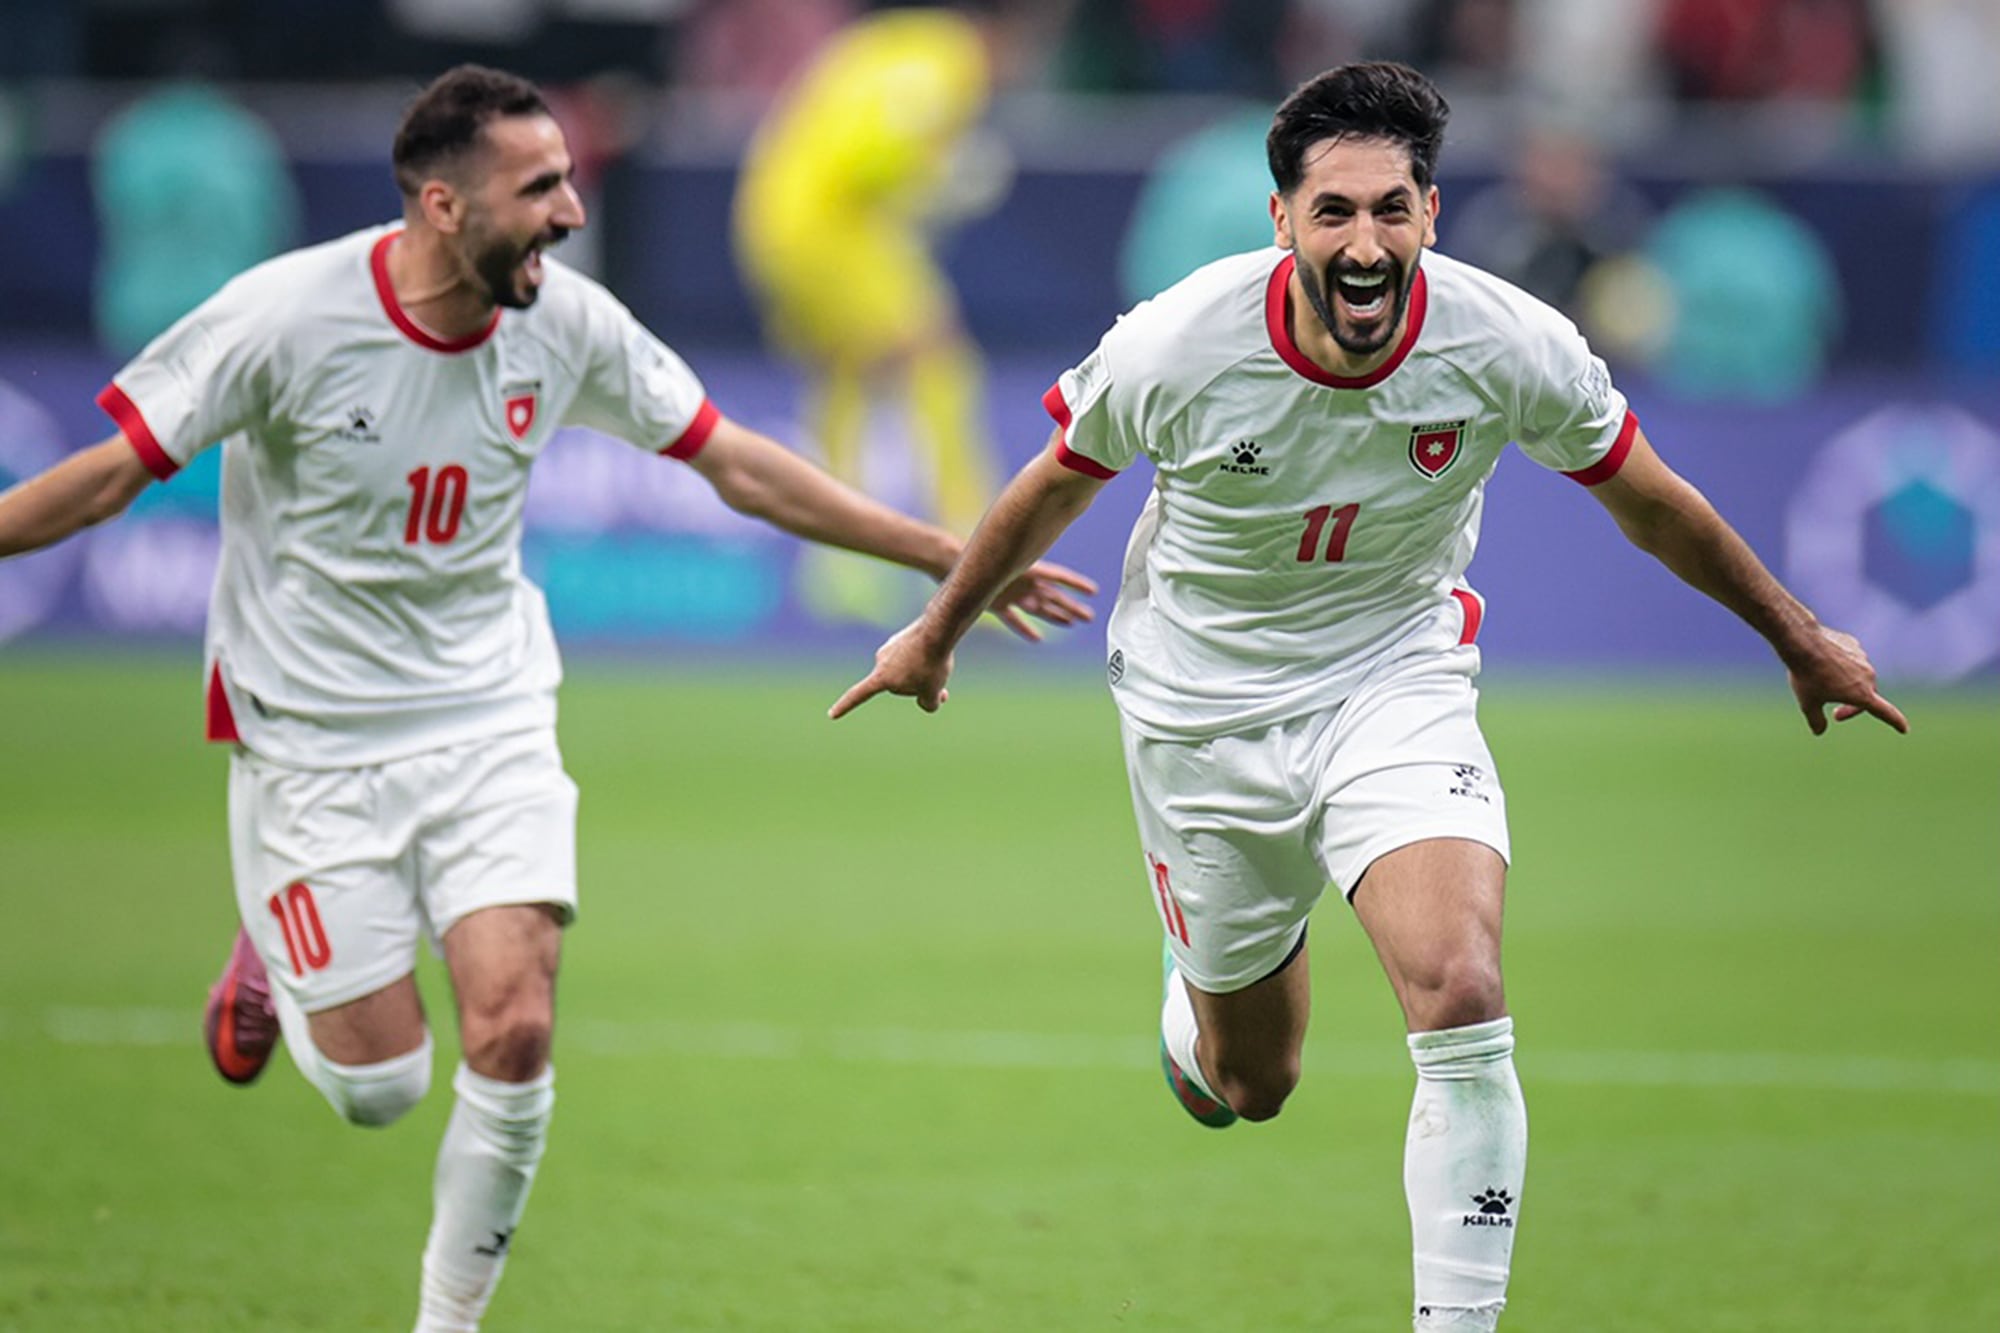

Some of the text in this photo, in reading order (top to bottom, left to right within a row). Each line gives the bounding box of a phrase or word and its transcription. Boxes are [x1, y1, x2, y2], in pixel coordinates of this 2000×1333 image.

[404, 464, 468, 545] 10
[1220, 463, 1270, 476] KELME
[1296, 503, 1360, 562] 11
[268, 880, 332, 978] 10
